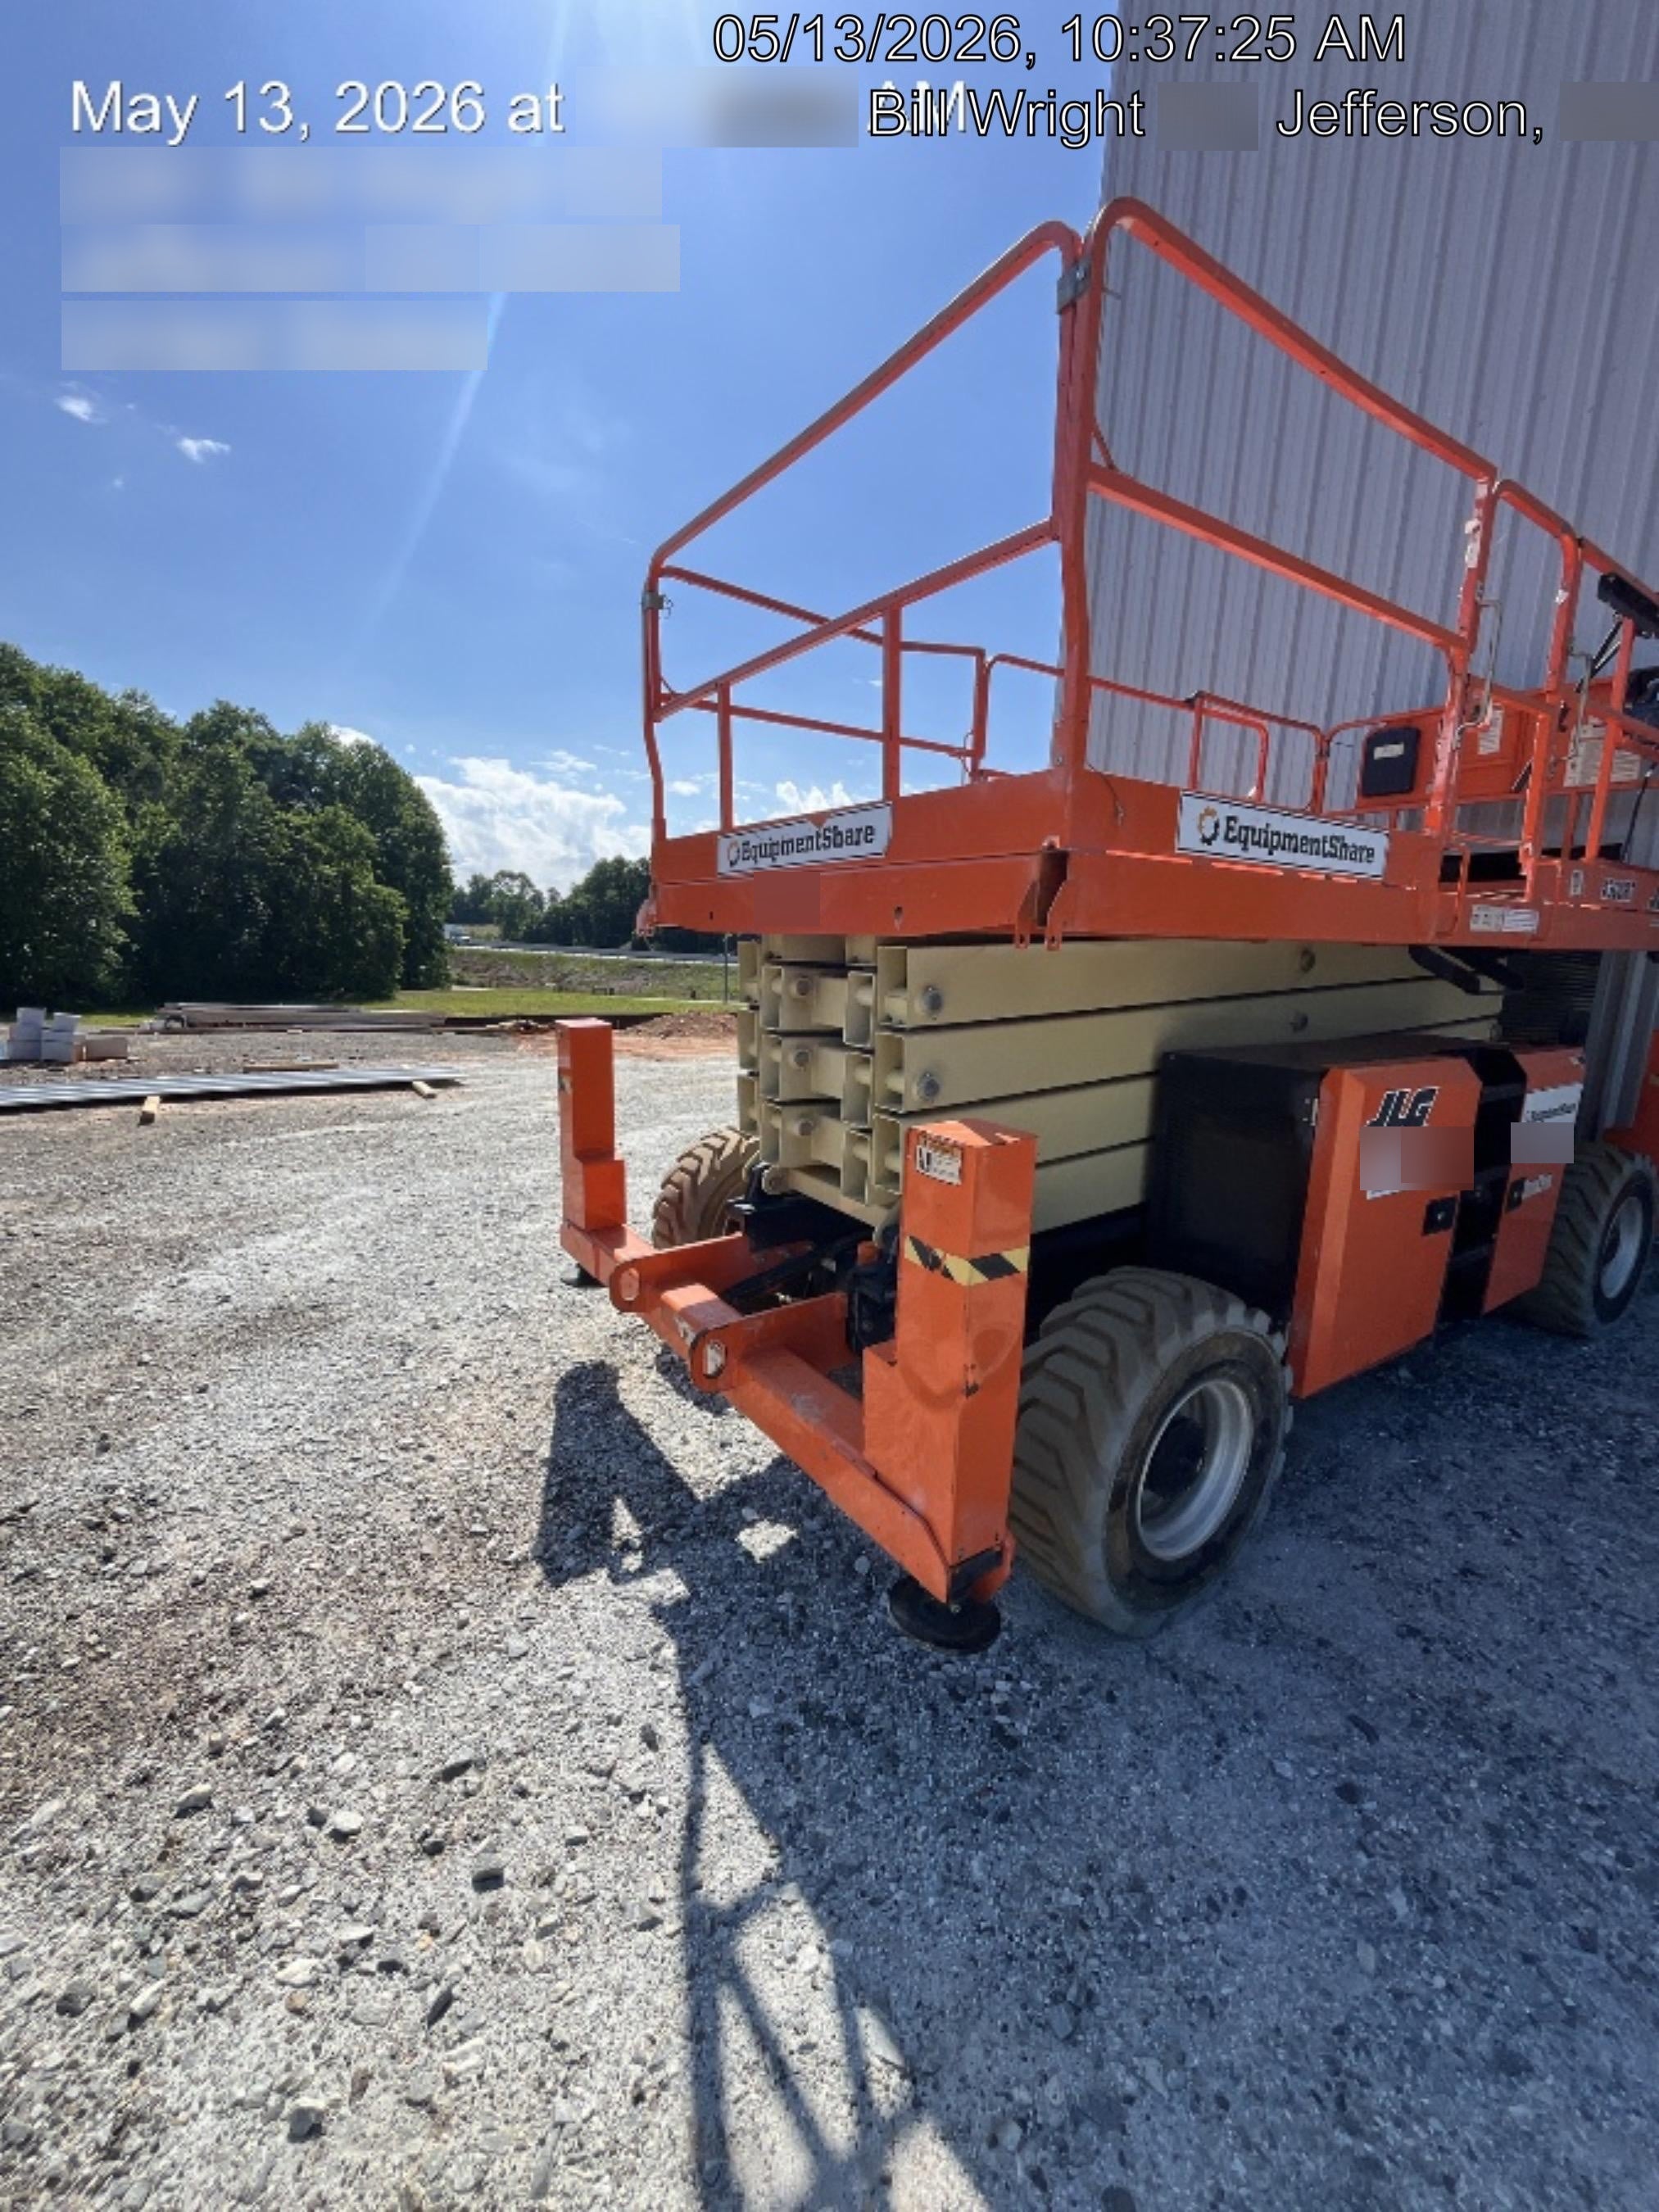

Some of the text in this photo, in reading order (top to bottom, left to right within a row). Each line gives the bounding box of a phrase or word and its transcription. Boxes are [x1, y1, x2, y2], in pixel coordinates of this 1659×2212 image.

[741, 824, 876, 865] EquipmentShare
[1223, 815, 1376, 864] EquipmentShare
[1362, 1086, 1439, 1127] JLG
